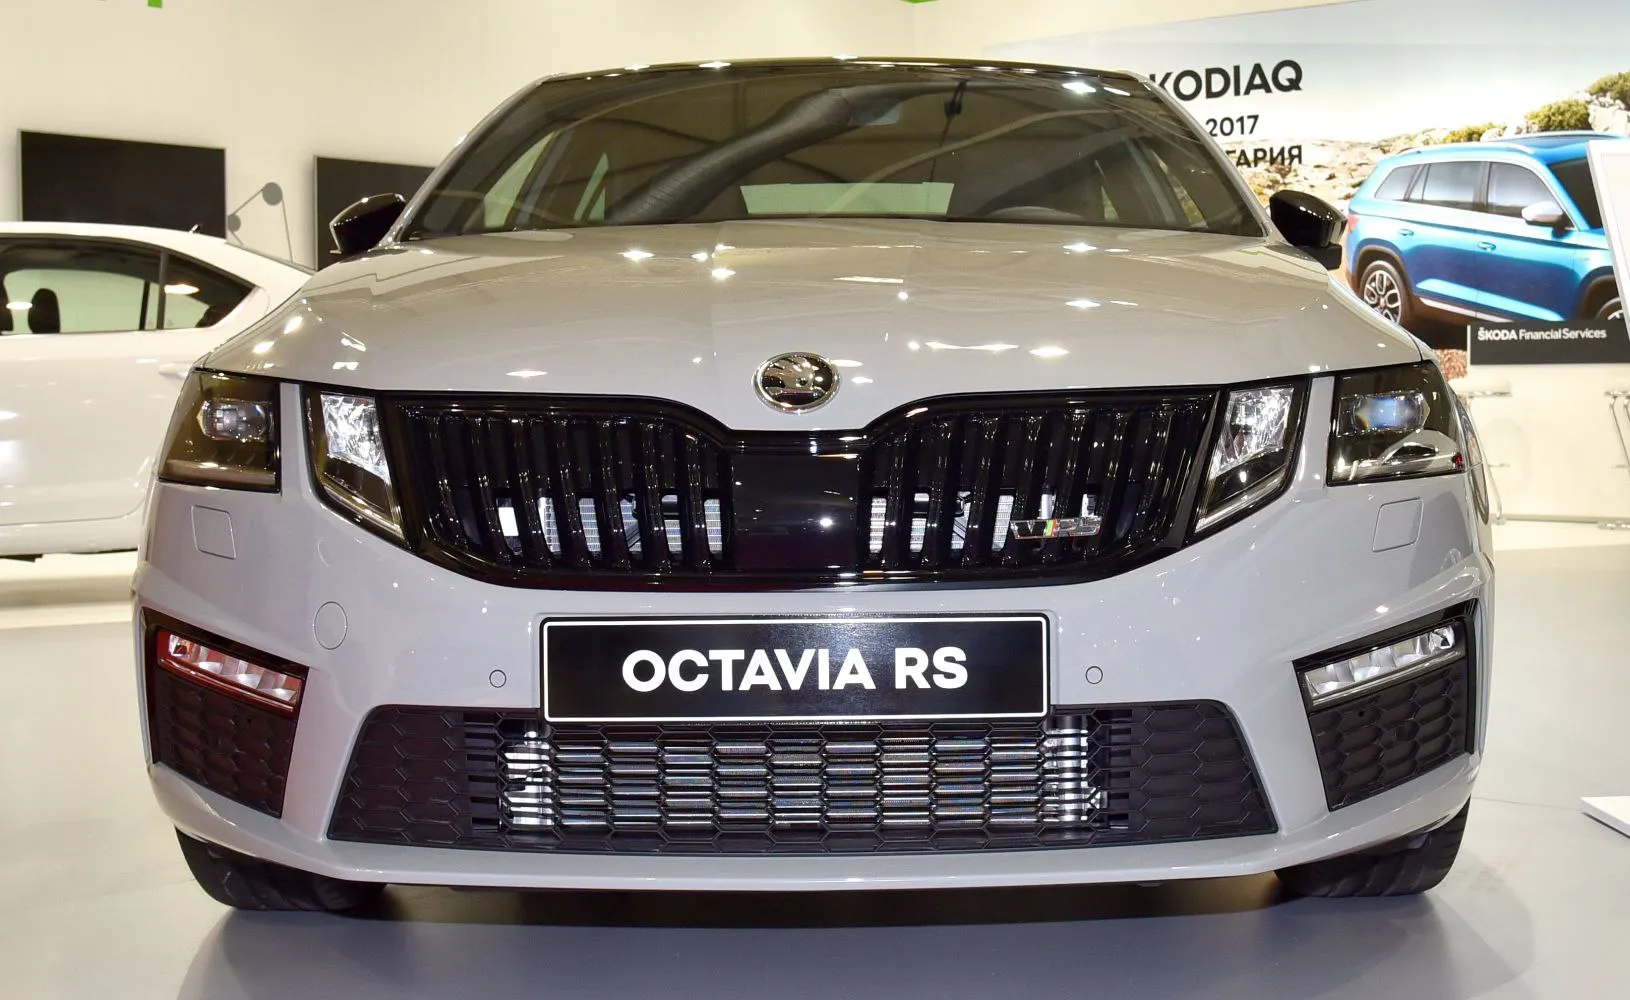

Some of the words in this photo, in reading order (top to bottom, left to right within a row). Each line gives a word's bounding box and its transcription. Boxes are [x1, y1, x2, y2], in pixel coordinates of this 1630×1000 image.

[1205, 114, 1259, 137] 2017
[1477, 326, 1518, 341] ŠKODA
[1519, 328, 1562, 340] Financial
[1562, 328, 1607, 339] Services
[622, 648, 877, 692] OCTAVIA
[894, 646, 968, 689] RS
